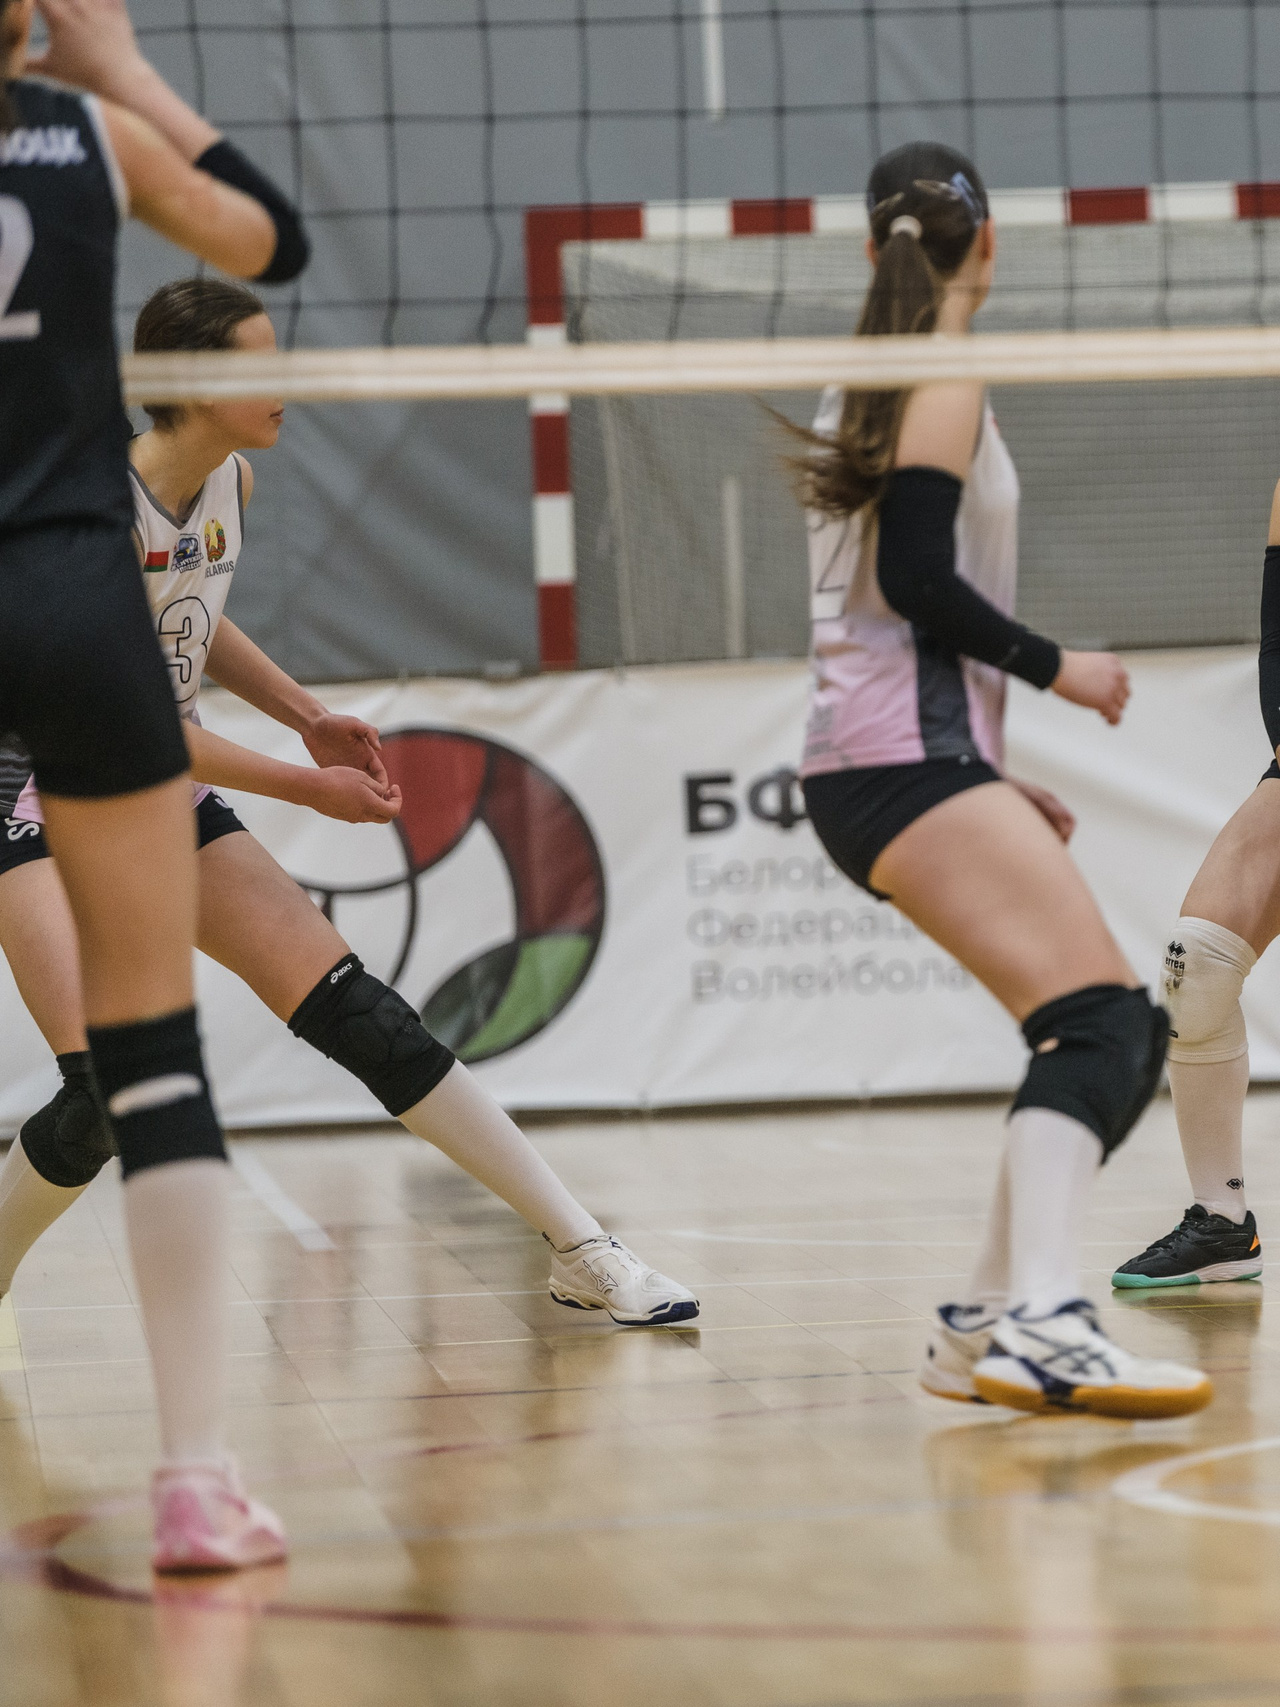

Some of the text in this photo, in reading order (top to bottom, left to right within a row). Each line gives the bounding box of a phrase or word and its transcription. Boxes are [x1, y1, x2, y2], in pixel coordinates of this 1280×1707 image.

[158, 596, 210, 703] 3
[684, 766, 809, 834] БФ
[686, 853, 842, 896] Белор
[687, 906, 918, 946] Федерац
[330, 962, 353, 984] asics
